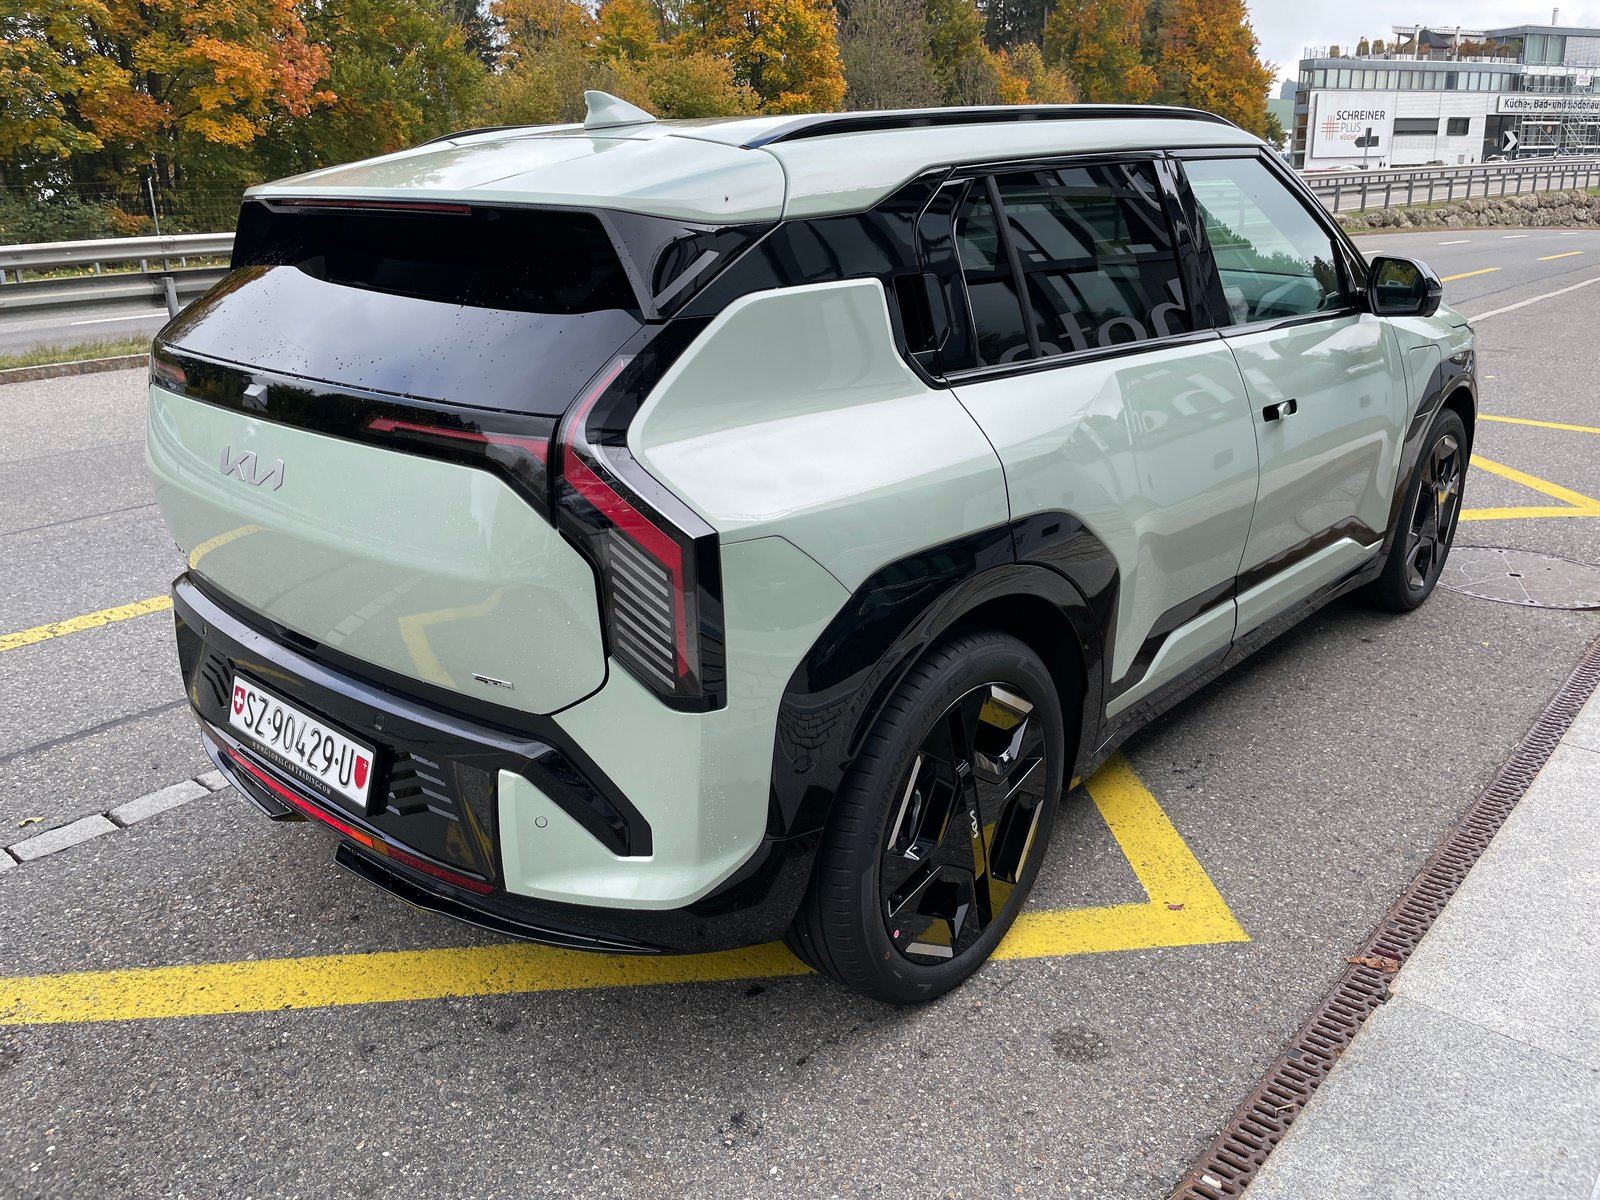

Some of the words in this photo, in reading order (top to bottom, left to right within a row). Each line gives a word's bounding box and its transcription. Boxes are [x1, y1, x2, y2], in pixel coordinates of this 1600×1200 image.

[1534, 99, 1551, 109] Bad-
[1552, 99, 1567, 109] und
[1336, 110, 1386, 121] SCHREINER
[1340, 122, 1362, 133] PLUS
